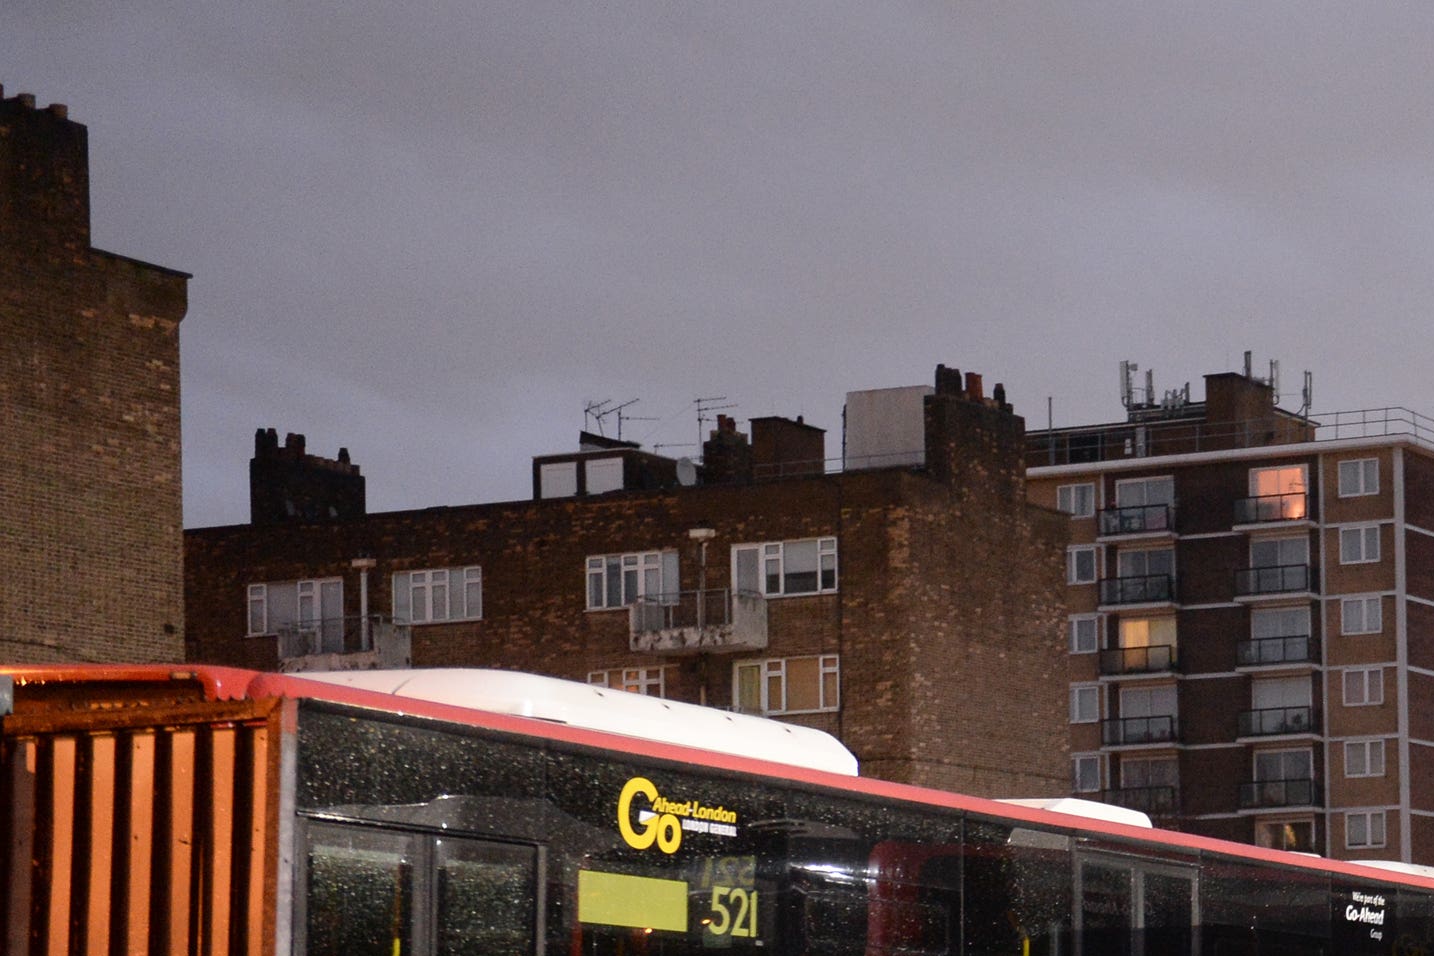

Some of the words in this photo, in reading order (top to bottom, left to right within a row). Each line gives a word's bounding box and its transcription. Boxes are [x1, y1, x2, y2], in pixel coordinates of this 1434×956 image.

[618, 776, 682, 854] Go
[708, 885, 757, 938] 521
[1346, 904, 1385, 926] Go-Ahead
